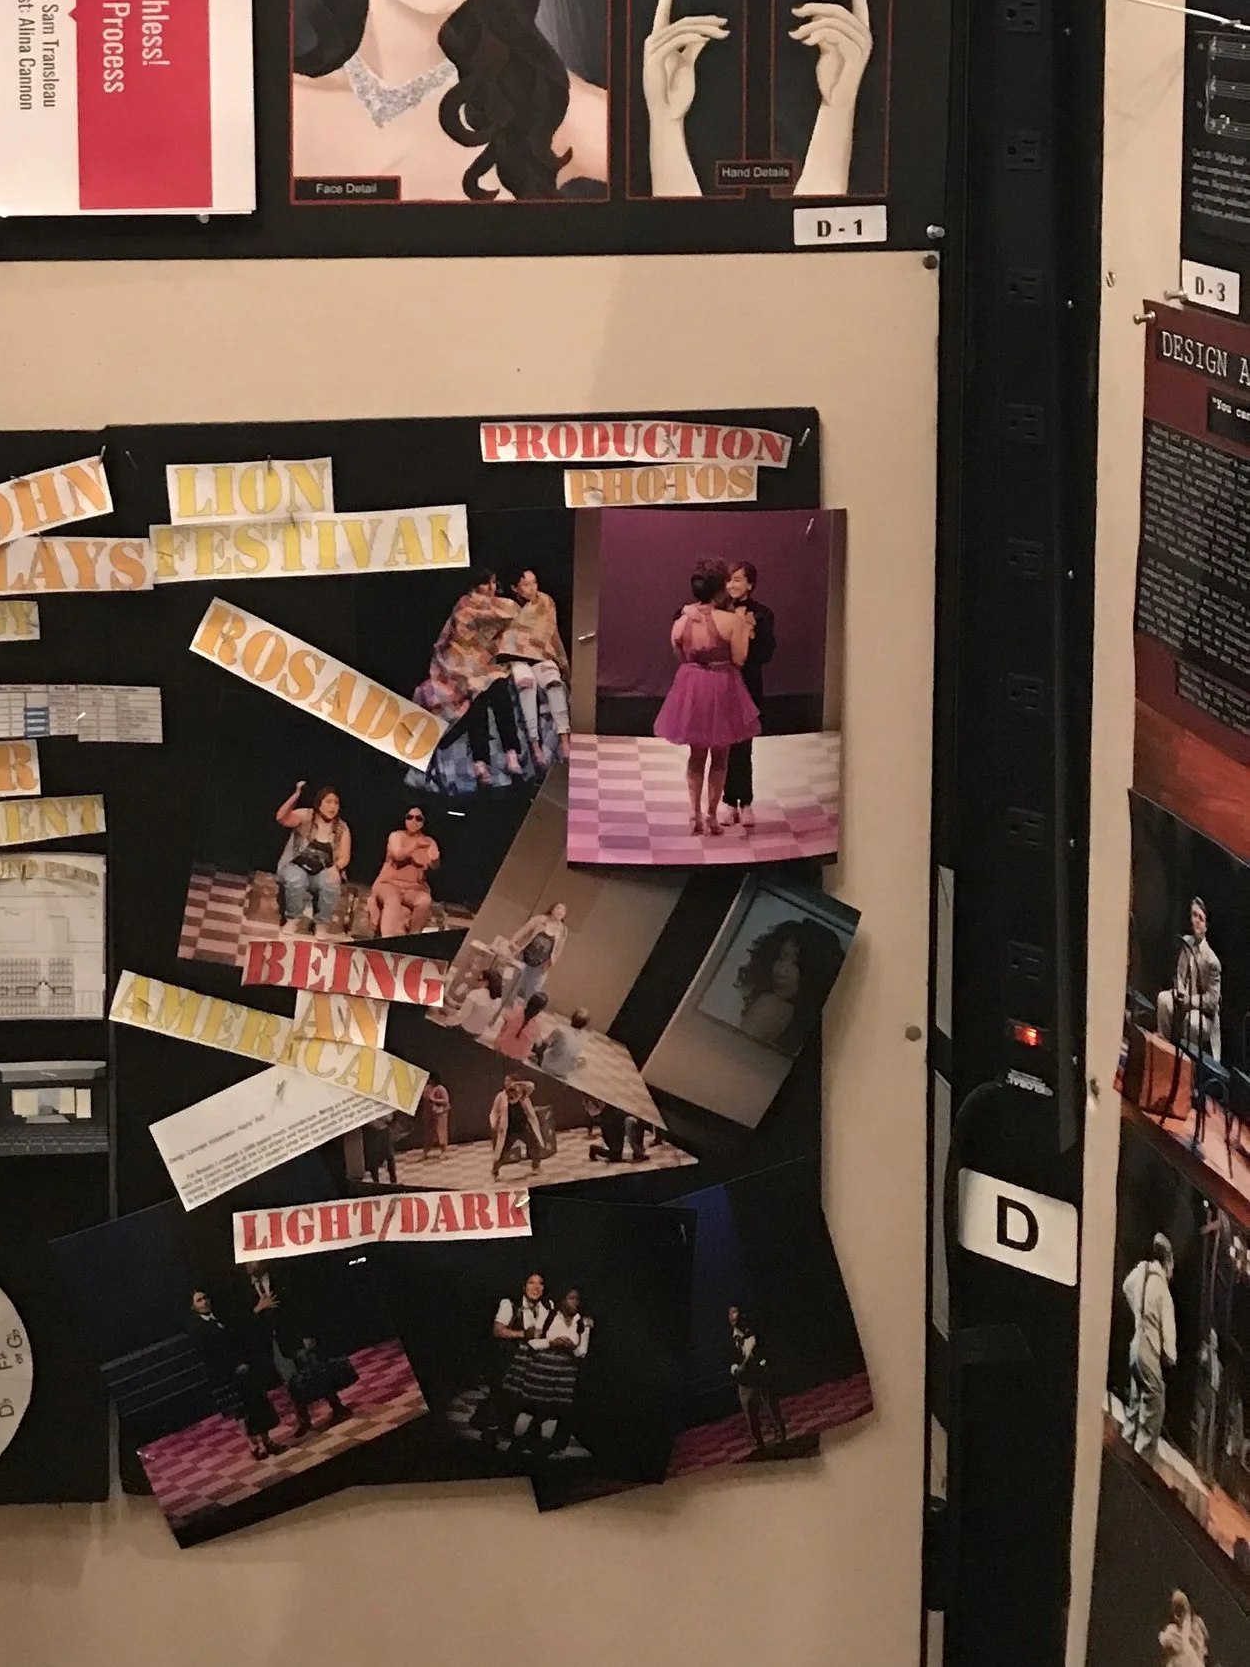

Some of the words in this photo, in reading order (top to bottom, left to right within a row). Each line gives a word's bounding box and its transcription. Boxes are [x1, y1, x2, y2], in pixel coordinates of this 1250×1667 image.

[18, 18, 36, 54] Alina
[41, 4, 59, 35] Sam
[103, 1, 131, 93] Process
[18, 57, 36, 111] Cannon
[41, 37, 60, 108] Transleau
[315, 182, 344, 195] Face
[346, 182, 377, 195] Detail
[721, 167, 750, 179] Hand
[753, 167, 790, 180] Details
[1162, 330, 1228, 377] DESIGN
[482, 422, 789, 464] PRODUCTION
[175, 461, 327, 519] LION
[570, 464, 754, 504] PHOTOS
[155, 512, 467, 579] FESTIVAL
[193, 601, 447, 763] ROSADO
[244, 940, 446, 1005] BEING
[293, 993, 386, 1050] AN
[242, 1190, 530, 1253] LIGHT/DARK
[996, 1194, 1039, 1253] D
